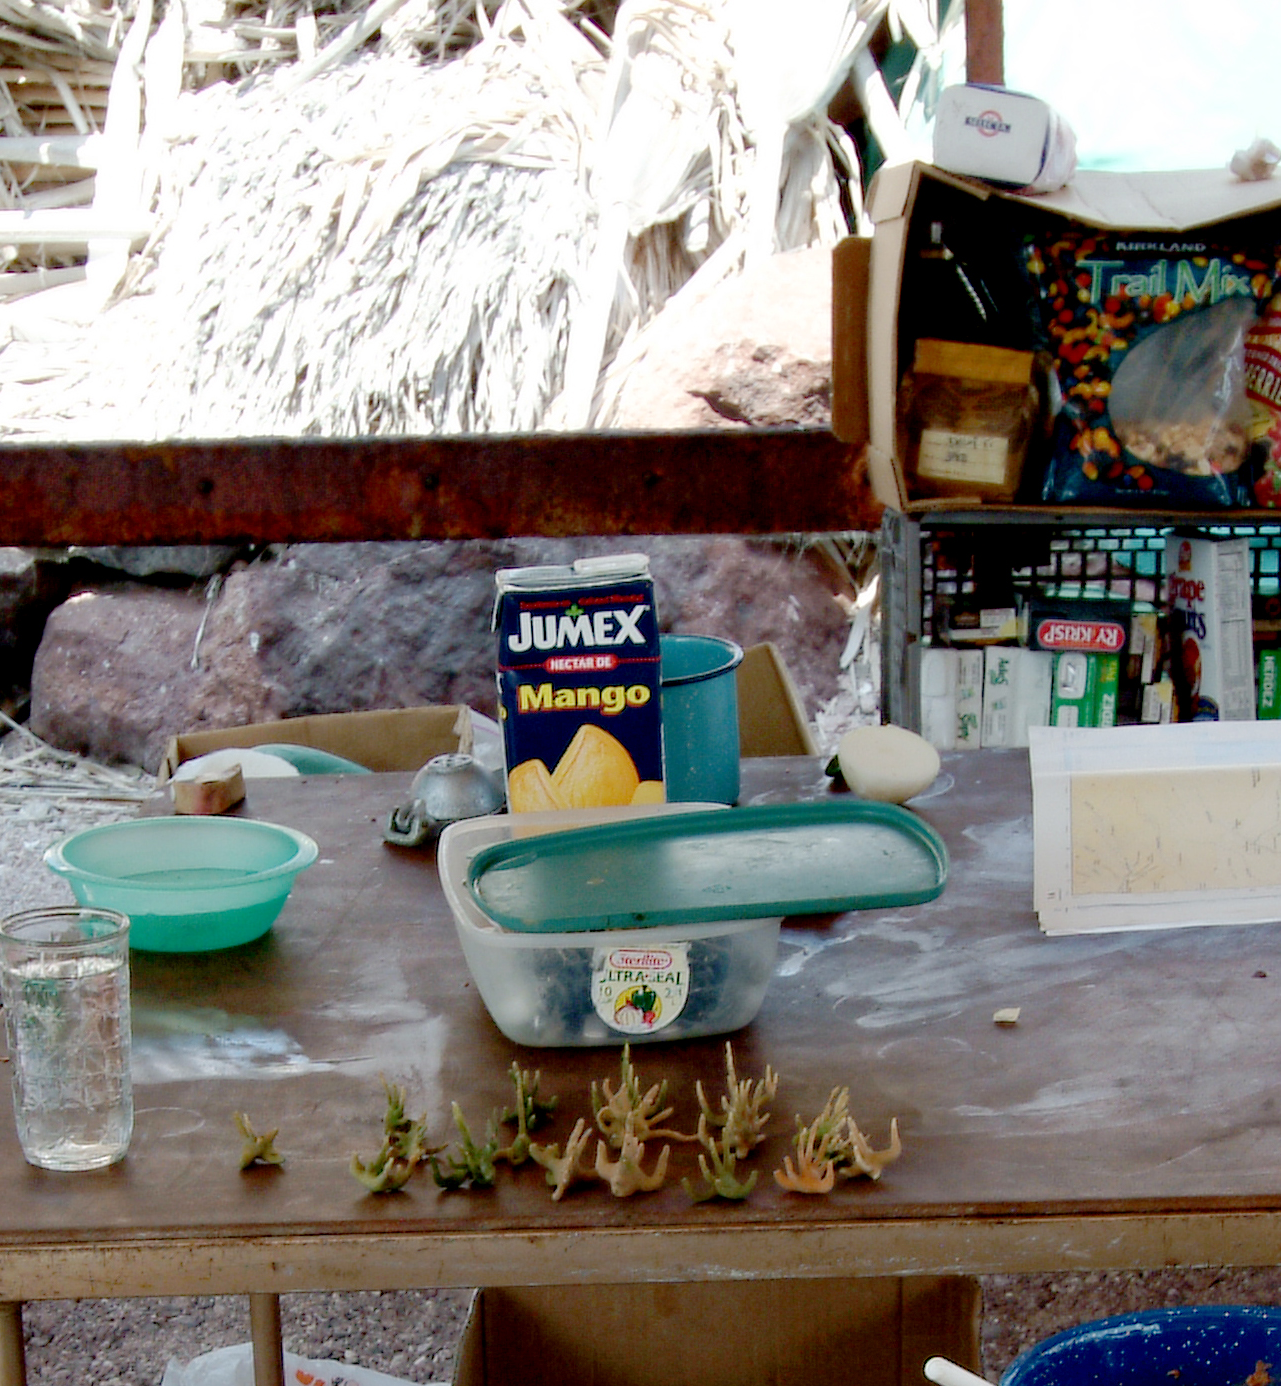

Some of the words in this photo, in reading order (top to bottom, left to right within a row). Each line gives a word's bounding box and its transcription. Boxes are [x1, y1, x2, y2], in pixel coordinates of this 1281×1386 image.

[1115, 241, 1207, 252] KIRKLAND
[1074, 258, 1168, 304] Trail
[1172, 257, 1251, 304] Mix
[507, 604, 647, 653] JUMEX
[1043, 624, 1092, 643] KRISP
[1095, 627, 1119, 647] RY
[550, 658, 595, 672] NECTAR
[595, 656, 613, 669] DE
[1262, 655, 1276, 708] HERDEZ
[517, 682, 651, 716] Mango
